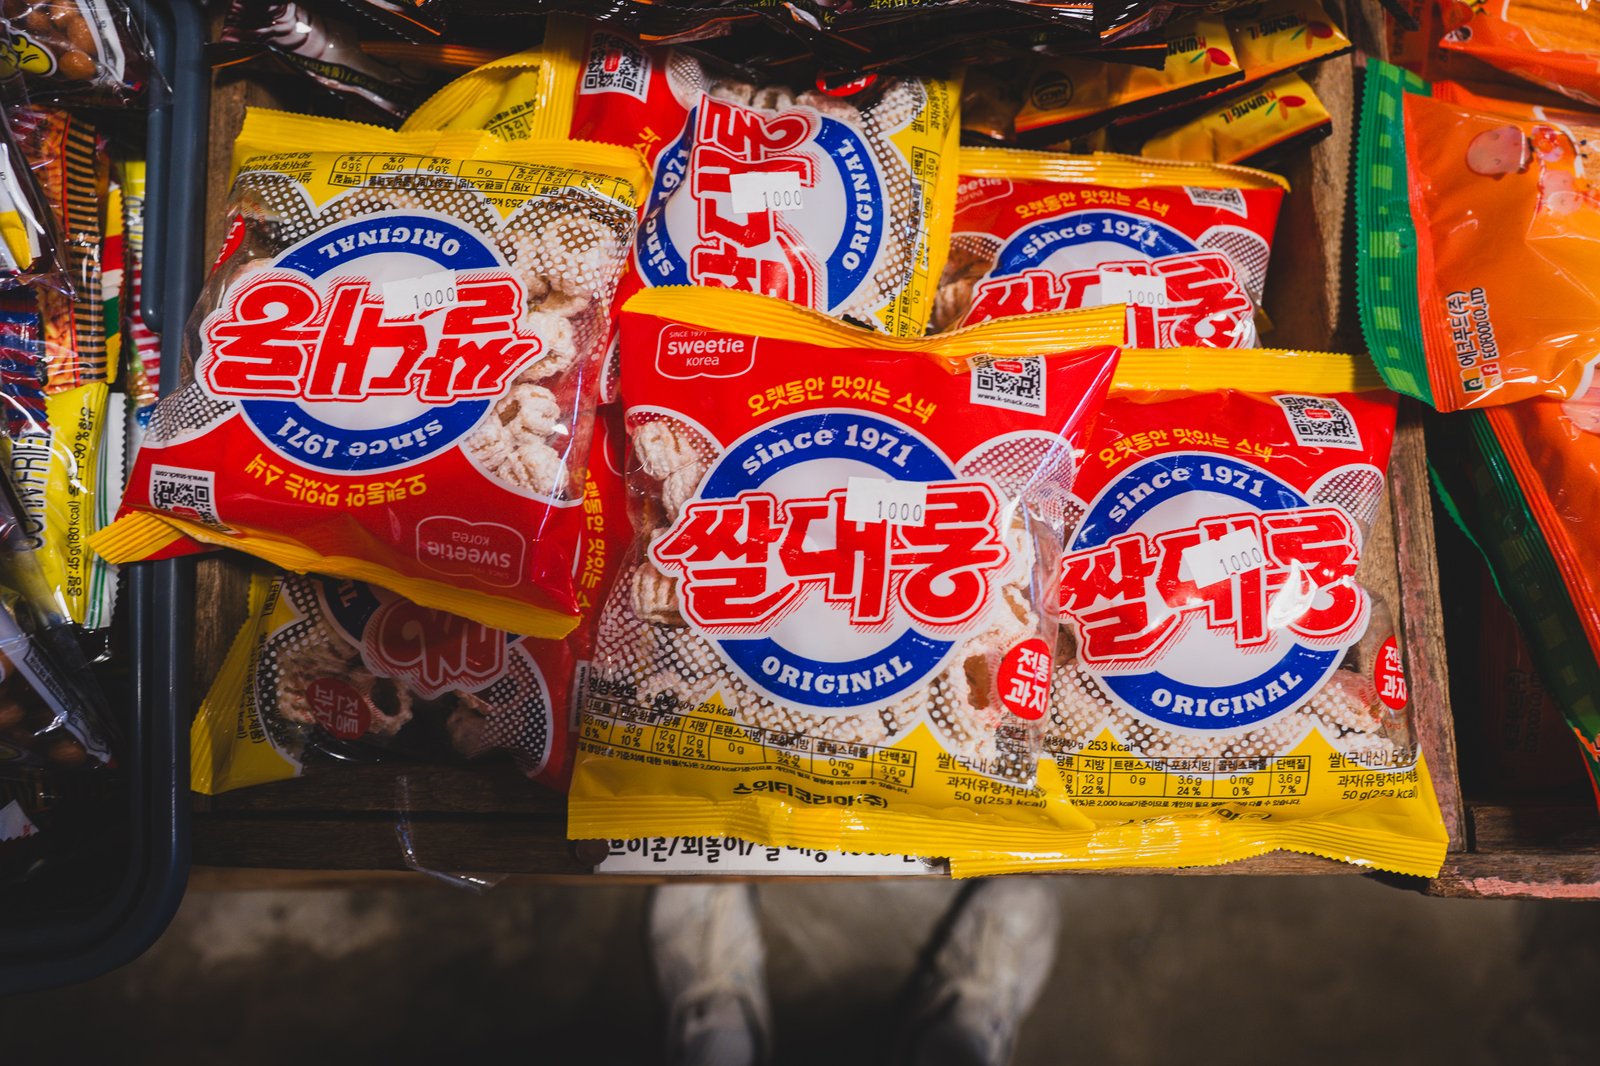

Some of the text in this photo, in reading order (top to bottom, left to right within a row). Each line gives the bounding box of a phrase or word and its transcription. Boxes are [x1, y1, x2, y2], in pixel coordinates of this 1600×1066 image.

[1218, 90, 1276, 125] KWANGIL
[512, 181, 530, 193] 지방
[762, 189, 803, 207] 1000
[957, 177, 1002, 195] eetie
[505, 199, 524, 208] 253
[836, 138, 874, 271] ORIGINAL
[1015, 188, 1170, 219] 오랫동안 맛있는 스낵
[317, 225, 462, 262] ORIGINAL
[1022, 218, 1159, 259] since 1971
[412, 286, 455, 311] 1000
[1128, 289, 1165, 306] 1000
[1445, 290, 1478, 367] 에코푸드(주)
[667, 338, 745, 355] sweetie
[685, 356, 720, 367] korea
[748, 375, 937, 424] 오랫동안 맛있는 스낵
[276, 416, 444, 460] since 1971
[742, 424, 914, 476] since 1971
[1098, 427, 1272, 469] 오랫동안 맛있는 스낵
[243, 452, 428, 508] 오랫동안 맛있는 스낵
[1108, 462, 1265, 524] since 1971
[876, 500, 923, 523] 1000
[451, 530, 490, 547] korea
[427, 541, 511, 568] sweetie
[580, 538, 605, 589] 맛있는
[660, 486, 1007, 626] 쌀대롱
[1218, 546, 1263, 575] 1000
[760, 653, 914, 696] ORIGINAL
[1016, 646, 1051, 682] 전통
[1004, 676, 1049, 712] 과자
[1151, 671, 1303, 719] ORIGINAL
[336, 695, 359, 735] 전통
[697, 702, 715, 714] 253
[716, 705, 738, 718] kcal
[621, 734, 631, 746] 10
[656, 741, 665, 752] 12
[682, 746, 693, 757] 22
[659, 730, 668, 742] 12
[686, 735, 695, 746] 12
[838, 760, 854, 771] mg
[662, 715, 682, 729] 당류
[690, 720, 708, 733] 지방
[713, 724, 763, 742] 트랜스지방
[816, 741, 869, 759] 콜레스테롤
[878, 750, 911, 765] 단백질
[1087, 740, 1107, 751] 253
[1110, 741, 1134, 752] kcal
[1084, 758, 1105, 771] 지방
[1113, 758, 1164, 771] 트랜스지방
[1171, 759, 1211, 771] 포화지방
[1276, 757, 1306, 771] 단백질
[1328, 750, 1388, 768] 쌀(국내산)
[732, 778, 888, 809] 스위티코리아(주)
[1081, 785, 1093, 794] 22
[1177, 786, 1189, 796] 24
[1085, 774, 1094, 784] 12
[1178, 775, 1193, 785] 3.6
[1239, 776, 1254, 786] mg
[1278, 774, 1294, 784] 3.6
[1342, 790, 1357, 800] 50
[954, 791, 1047, 809] 50 g(253 kcal)
[1096, 799, 1118, 807] 2,000
